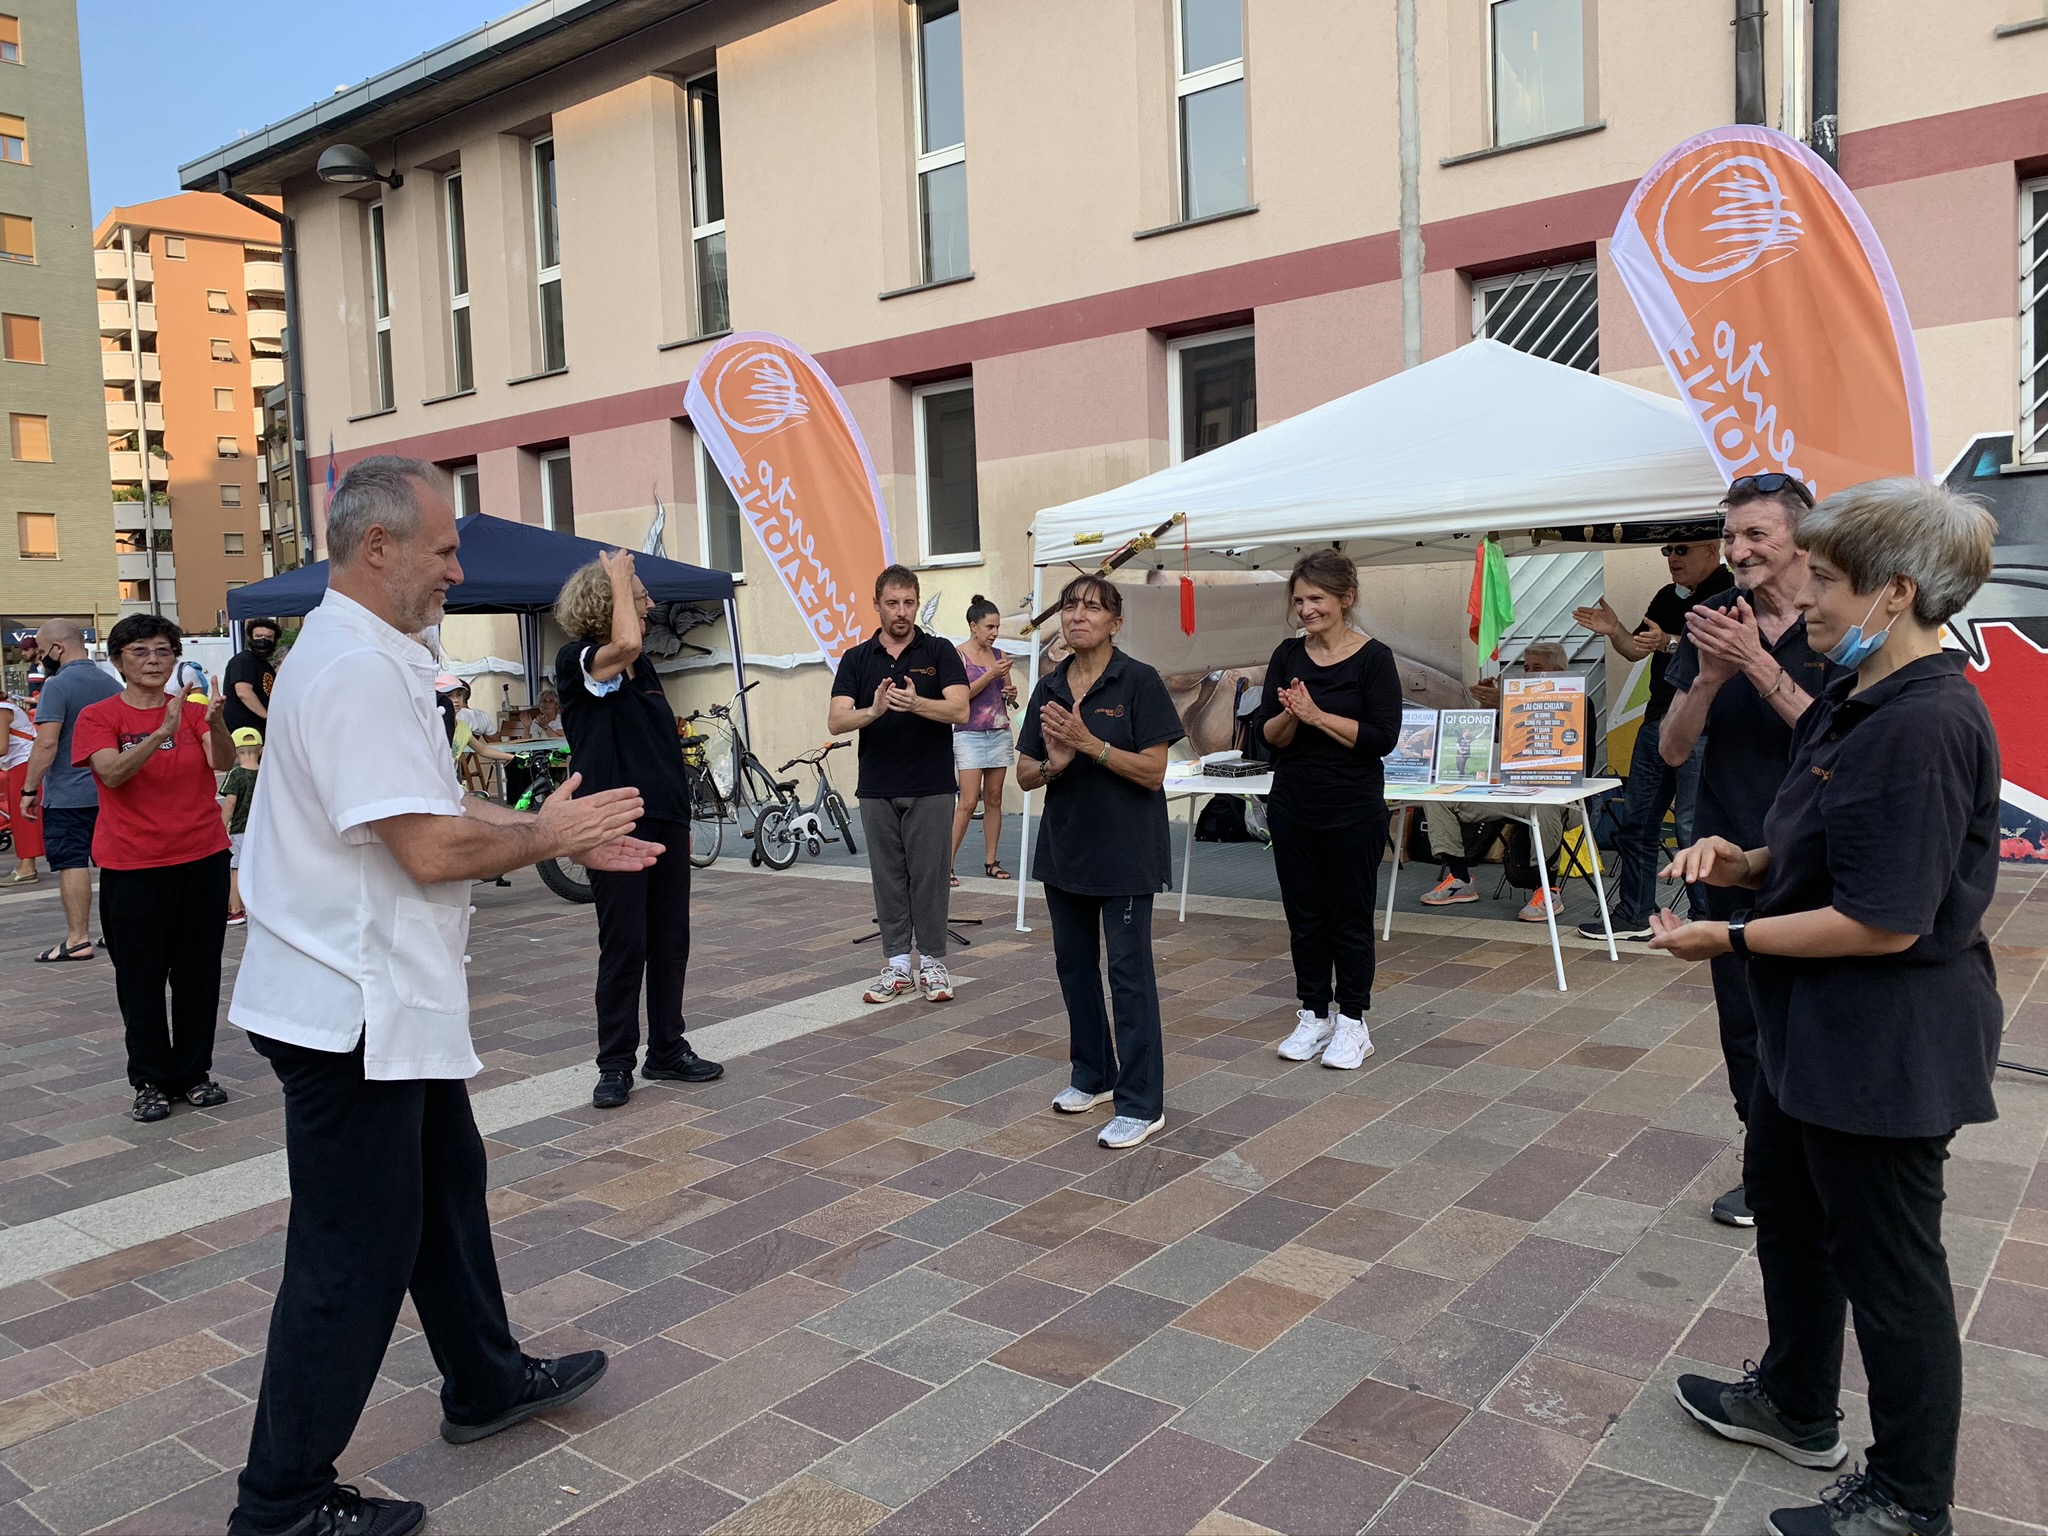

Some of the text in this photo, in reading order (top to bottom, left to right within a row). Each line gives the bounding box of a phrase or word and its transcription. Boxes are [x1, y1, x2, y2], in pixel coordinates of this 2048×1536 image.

[1523, 702, 1564, 711] TAI CHI CHUAN
[1445, 715, 1491, 724] QI GONG
